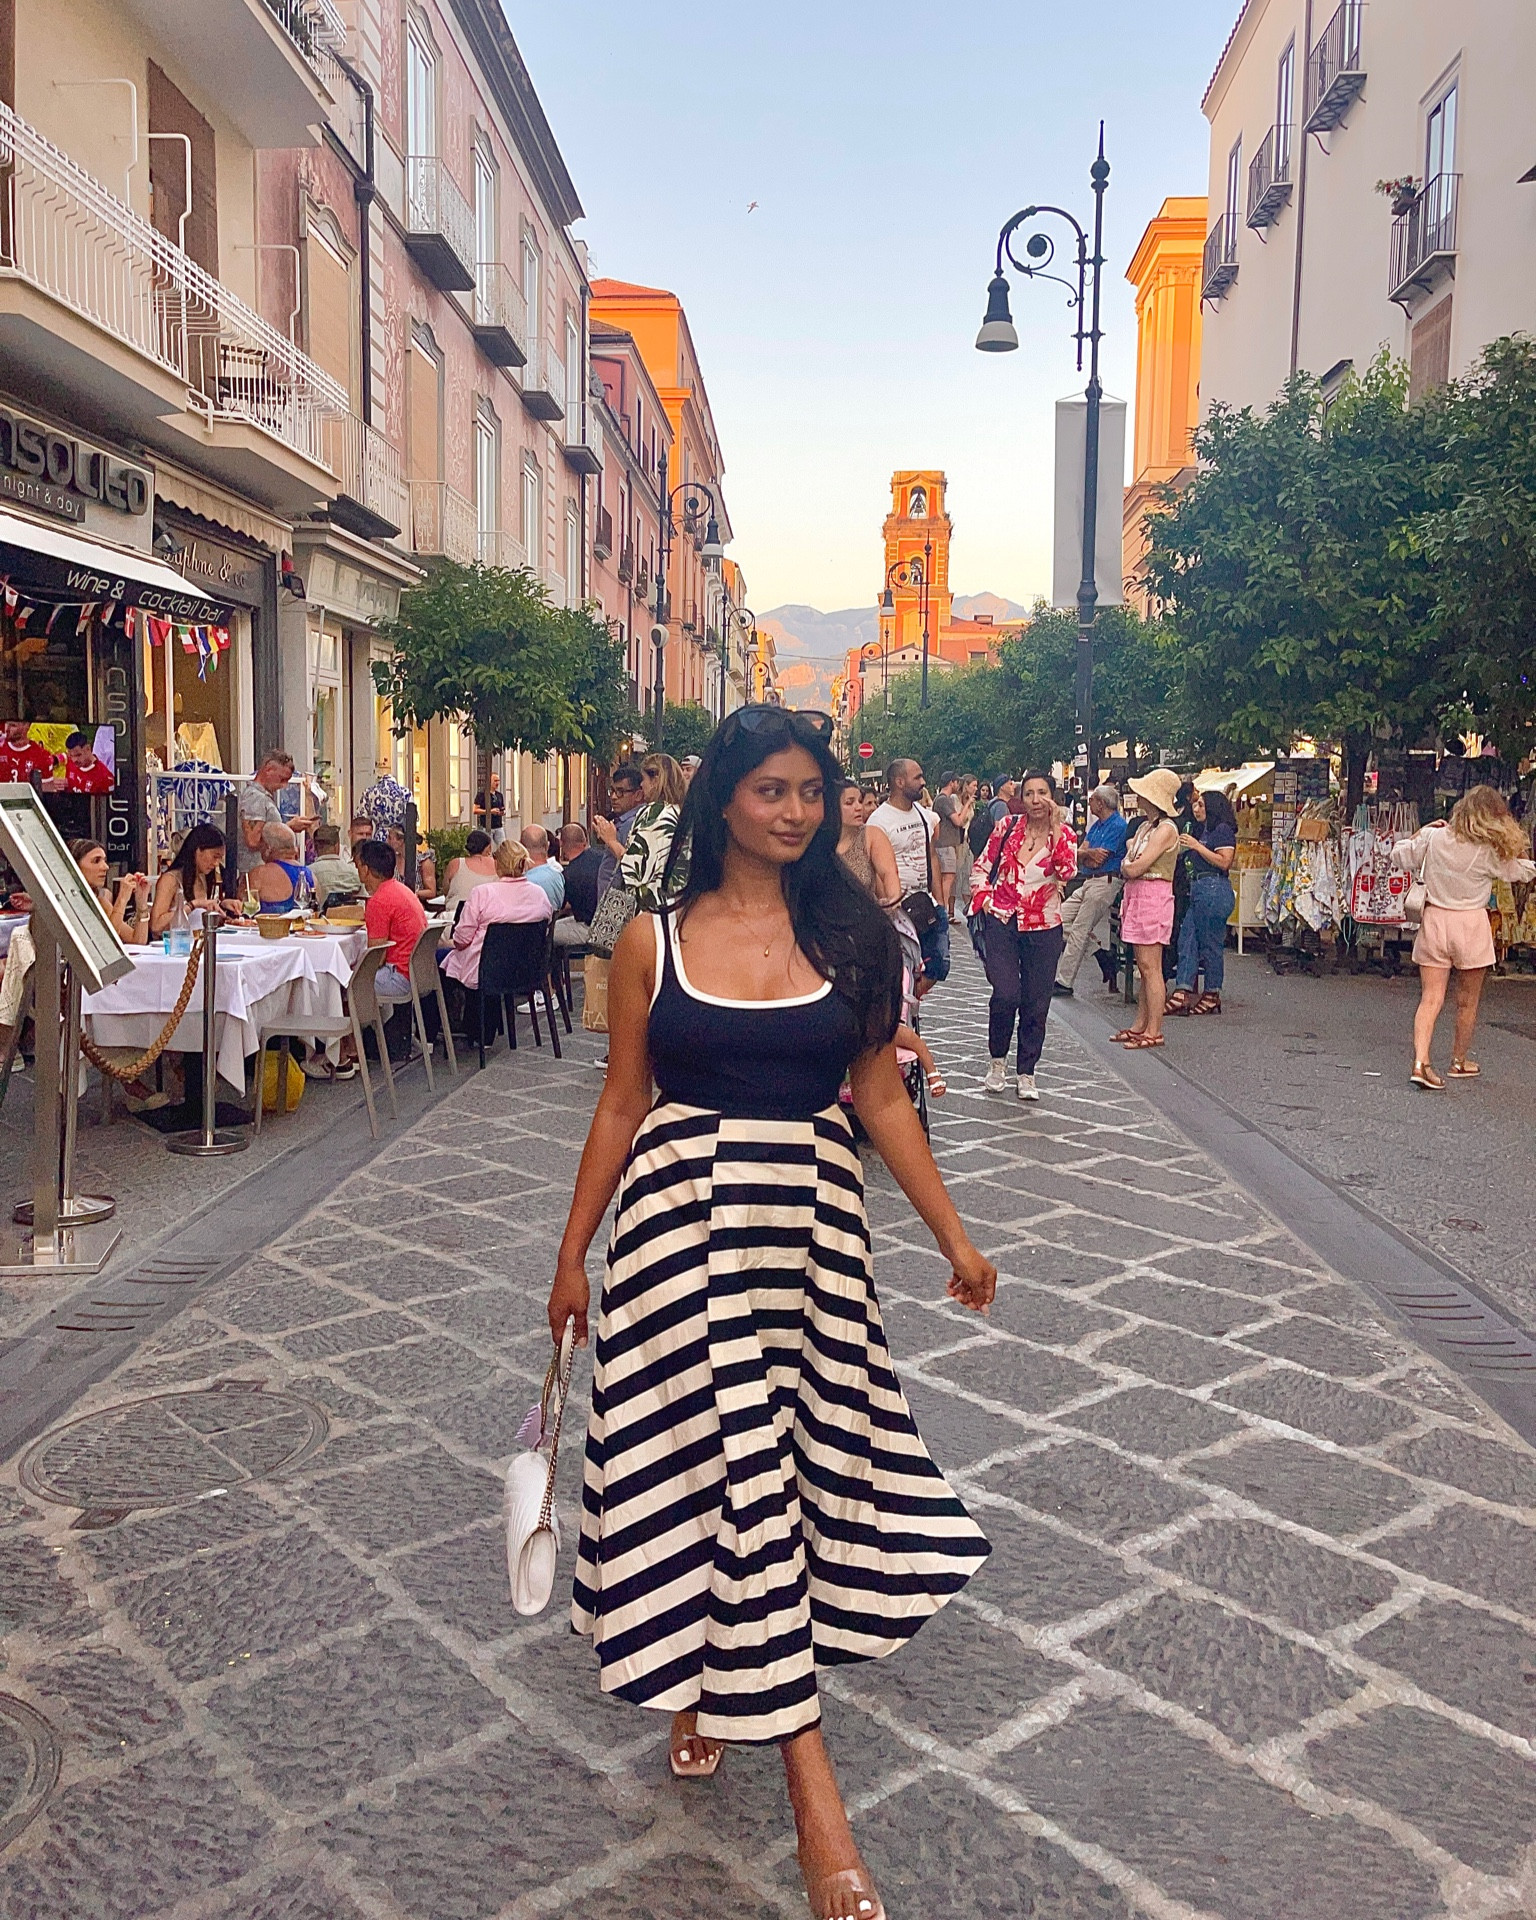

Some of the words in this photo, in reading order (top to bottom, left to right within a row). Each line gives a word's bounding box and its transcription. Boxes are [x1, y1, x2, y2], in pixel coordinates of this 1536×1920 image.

[3, 475, 40, 498] night
[44, 489, 51, 504] &
[56, 496, 80, 517] day
[66, 569, 109, 595] wine
[110, 580, 126, 600] &
[138, 590, 196, 621] cocktail
[199, 602, 225, 623] bar
[107, 842, 130, 851] bar
